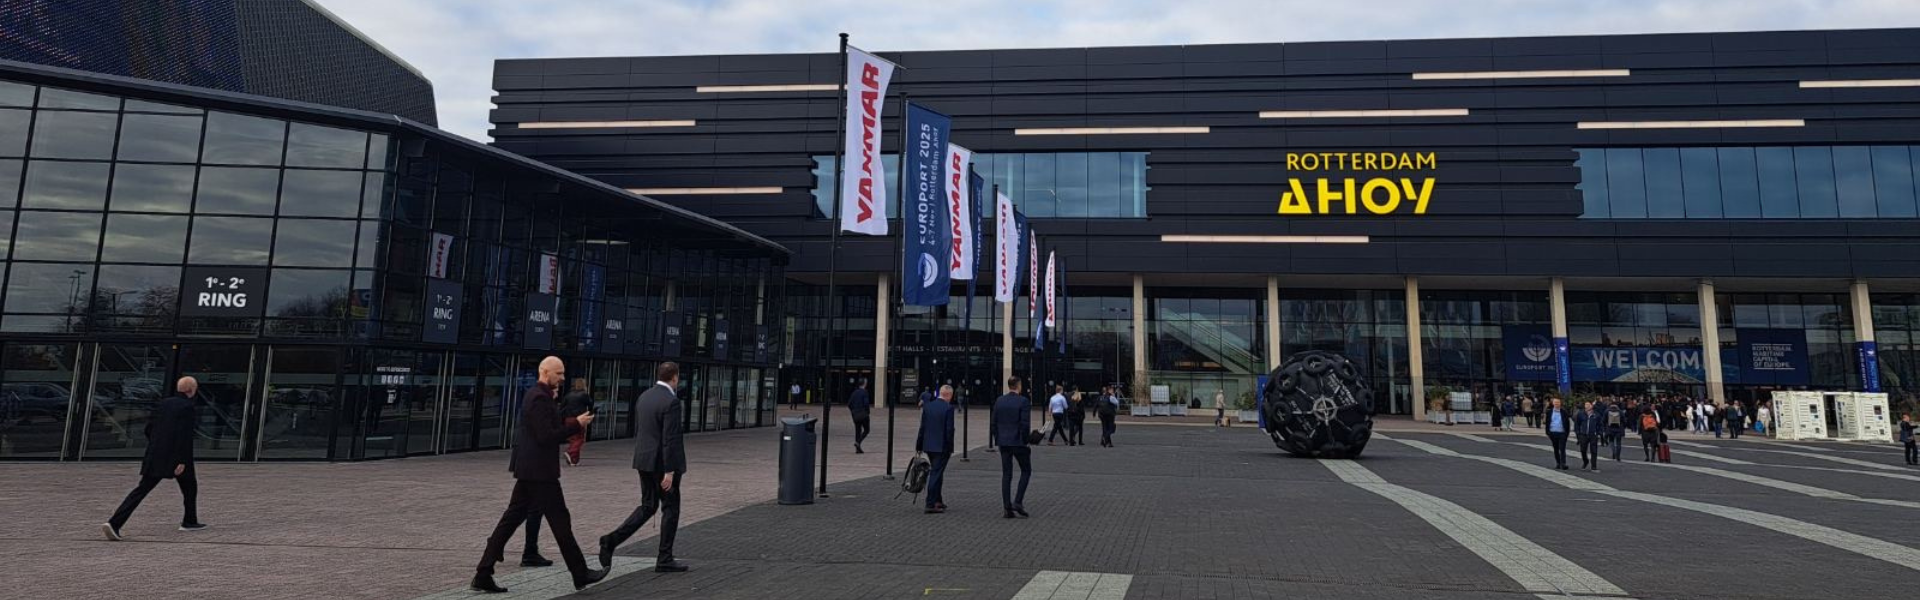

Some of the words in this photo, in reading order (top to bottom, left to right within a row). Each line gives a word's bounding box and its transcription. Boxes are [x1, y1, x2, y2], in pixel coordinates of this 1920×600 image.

[857, 62, 879, 223] YANMAR
[919, 123, 930, 158] 2025
[1286, 152, 1436, 171] ROTTERDAM
[918, 163, 928, 244] EUROPORT
[1277, 177, 1436, 215] AHOY
[952, 152, 962, 271] YANMAR
[198, 292, 247, 308] RING
[433, 307, 453, 320] RING
[529, 310, 550, 323] ARENA
[1592, 350, 1700, 370] WELCOM
